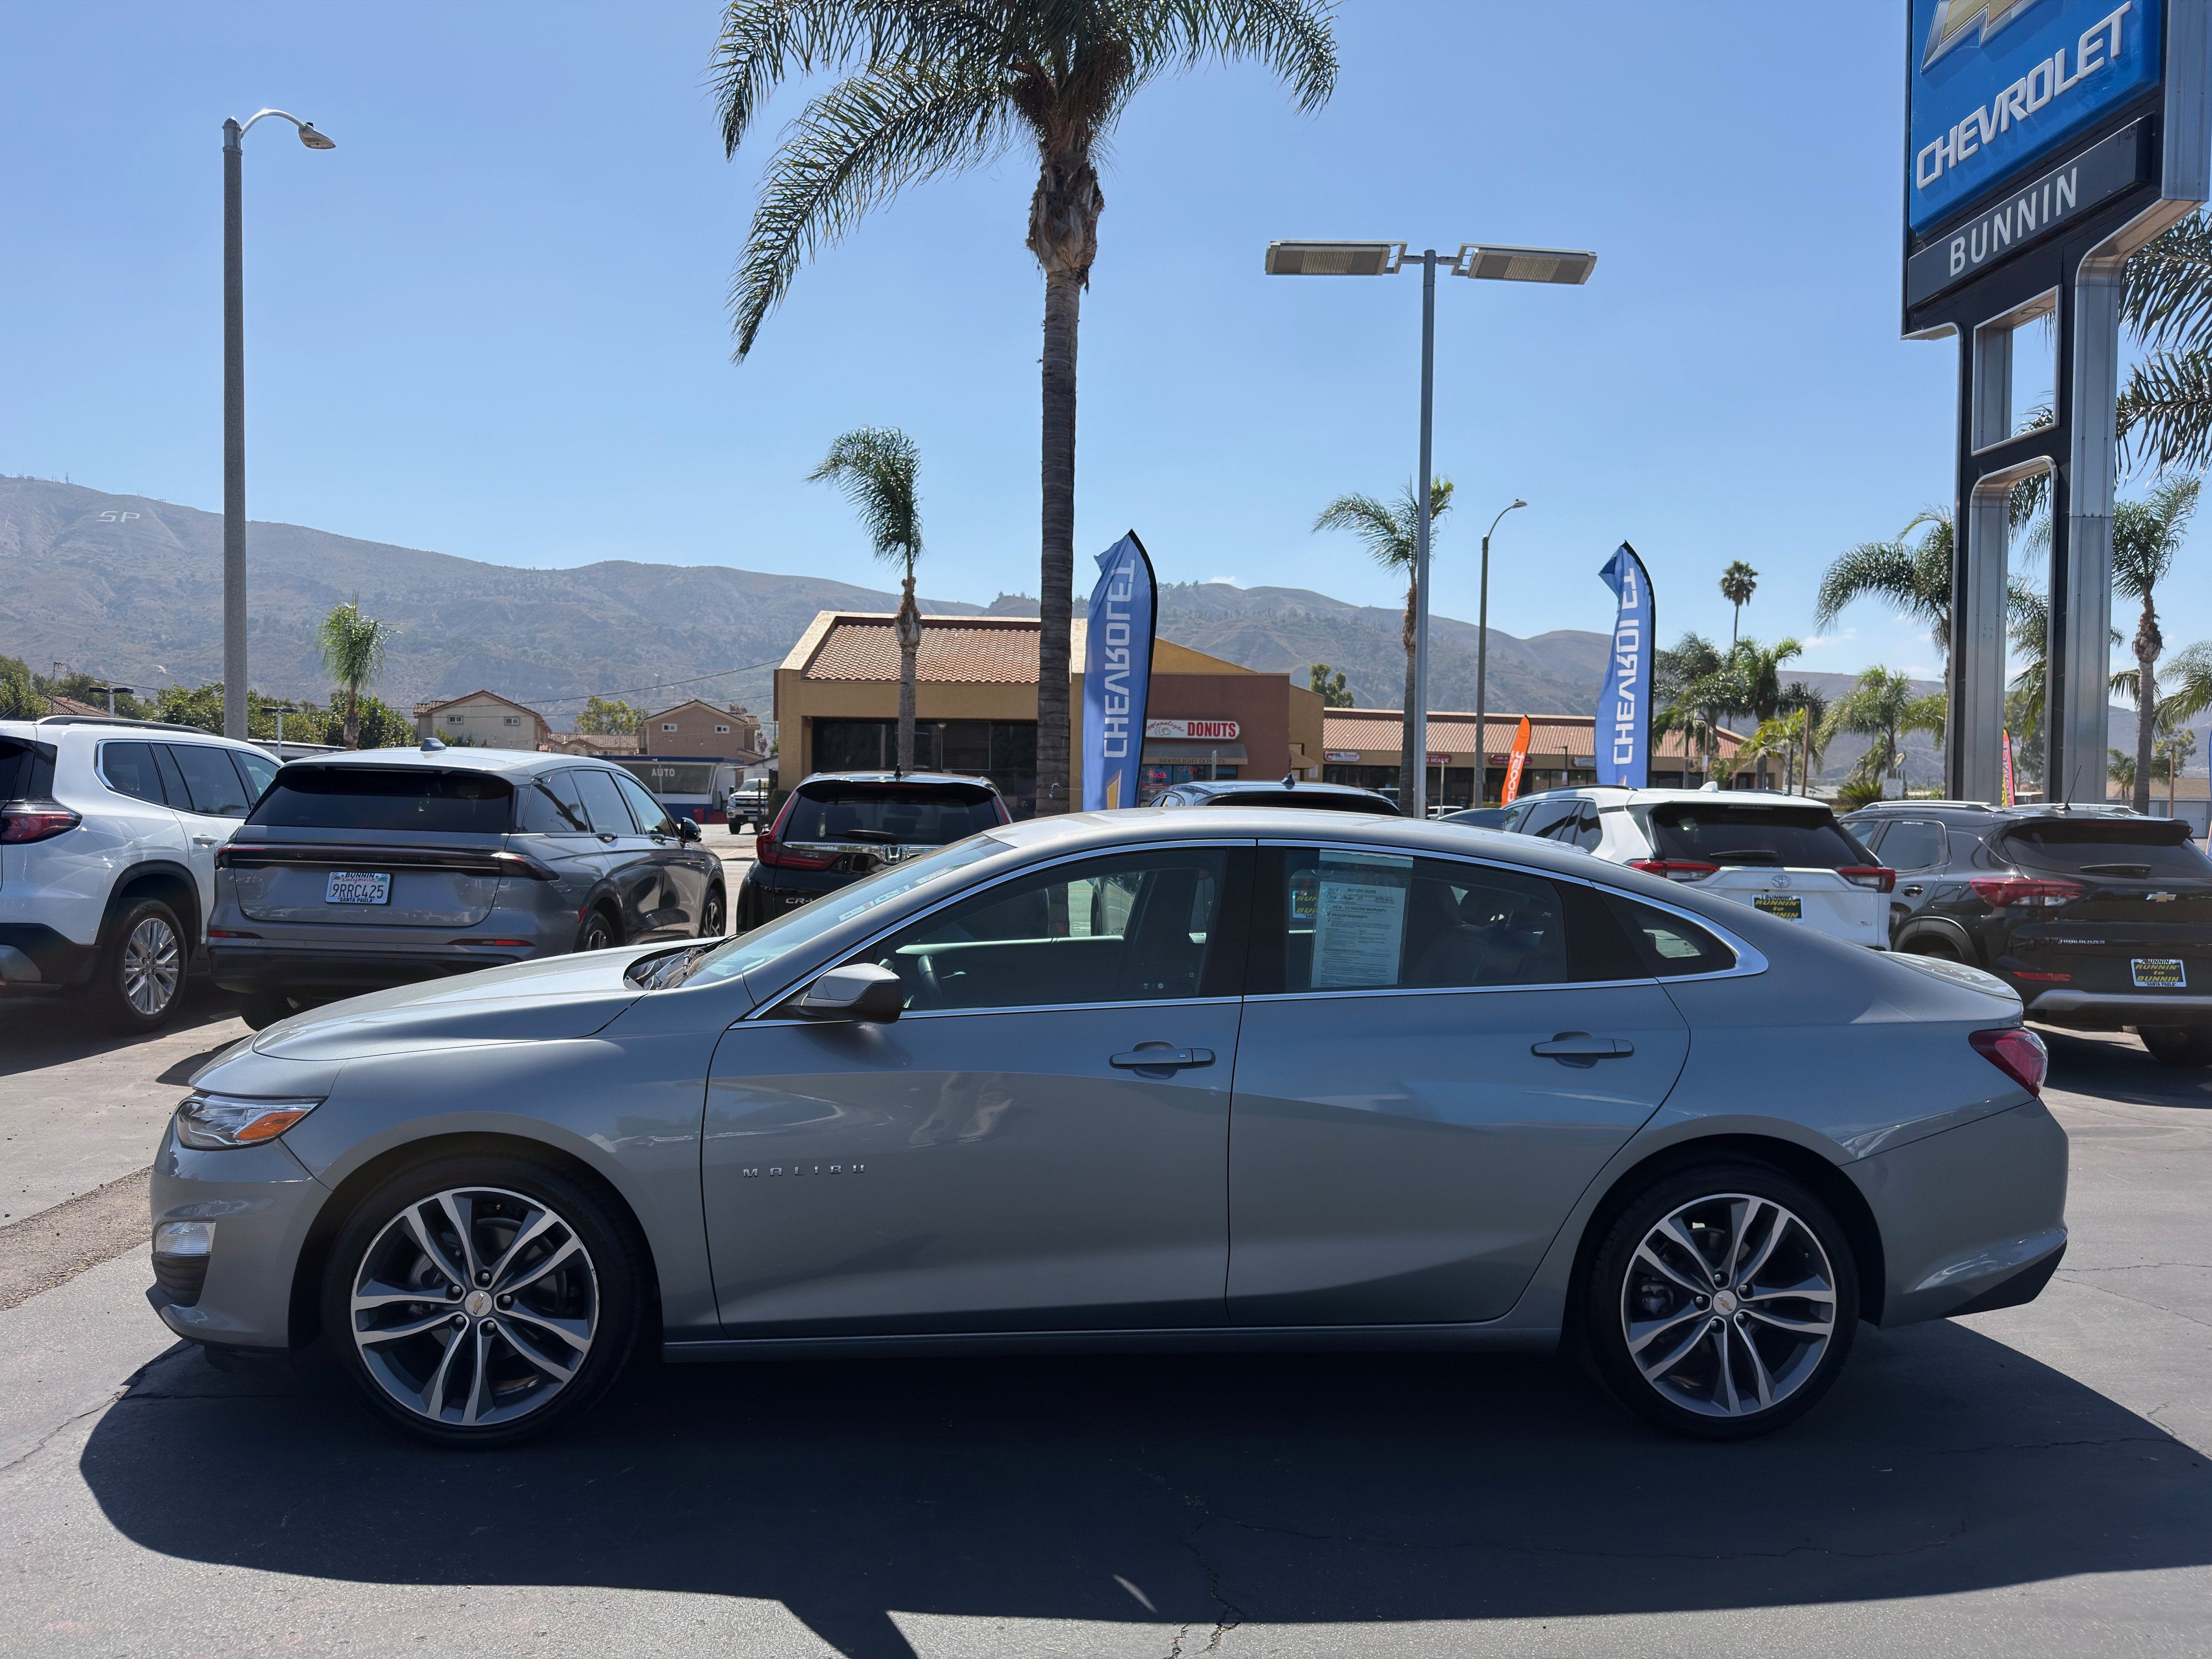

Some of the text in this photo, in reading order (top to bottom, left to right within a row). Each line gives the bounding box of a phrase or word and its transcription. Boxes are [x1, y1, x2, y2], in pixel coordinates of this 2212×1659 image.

[1917, 1, 2131, 190] CHEVROLET
[1949, 167, 2078, 277] BUNNIN
[96, 511, 140, 522] SP
[1187, 722, 1235, 737] DONUTS
[651, 768, 675, 777] AUTO
[331, 884, 383, 898] 9RRC425
[743, 1164, 865, 1178] MALIBU
